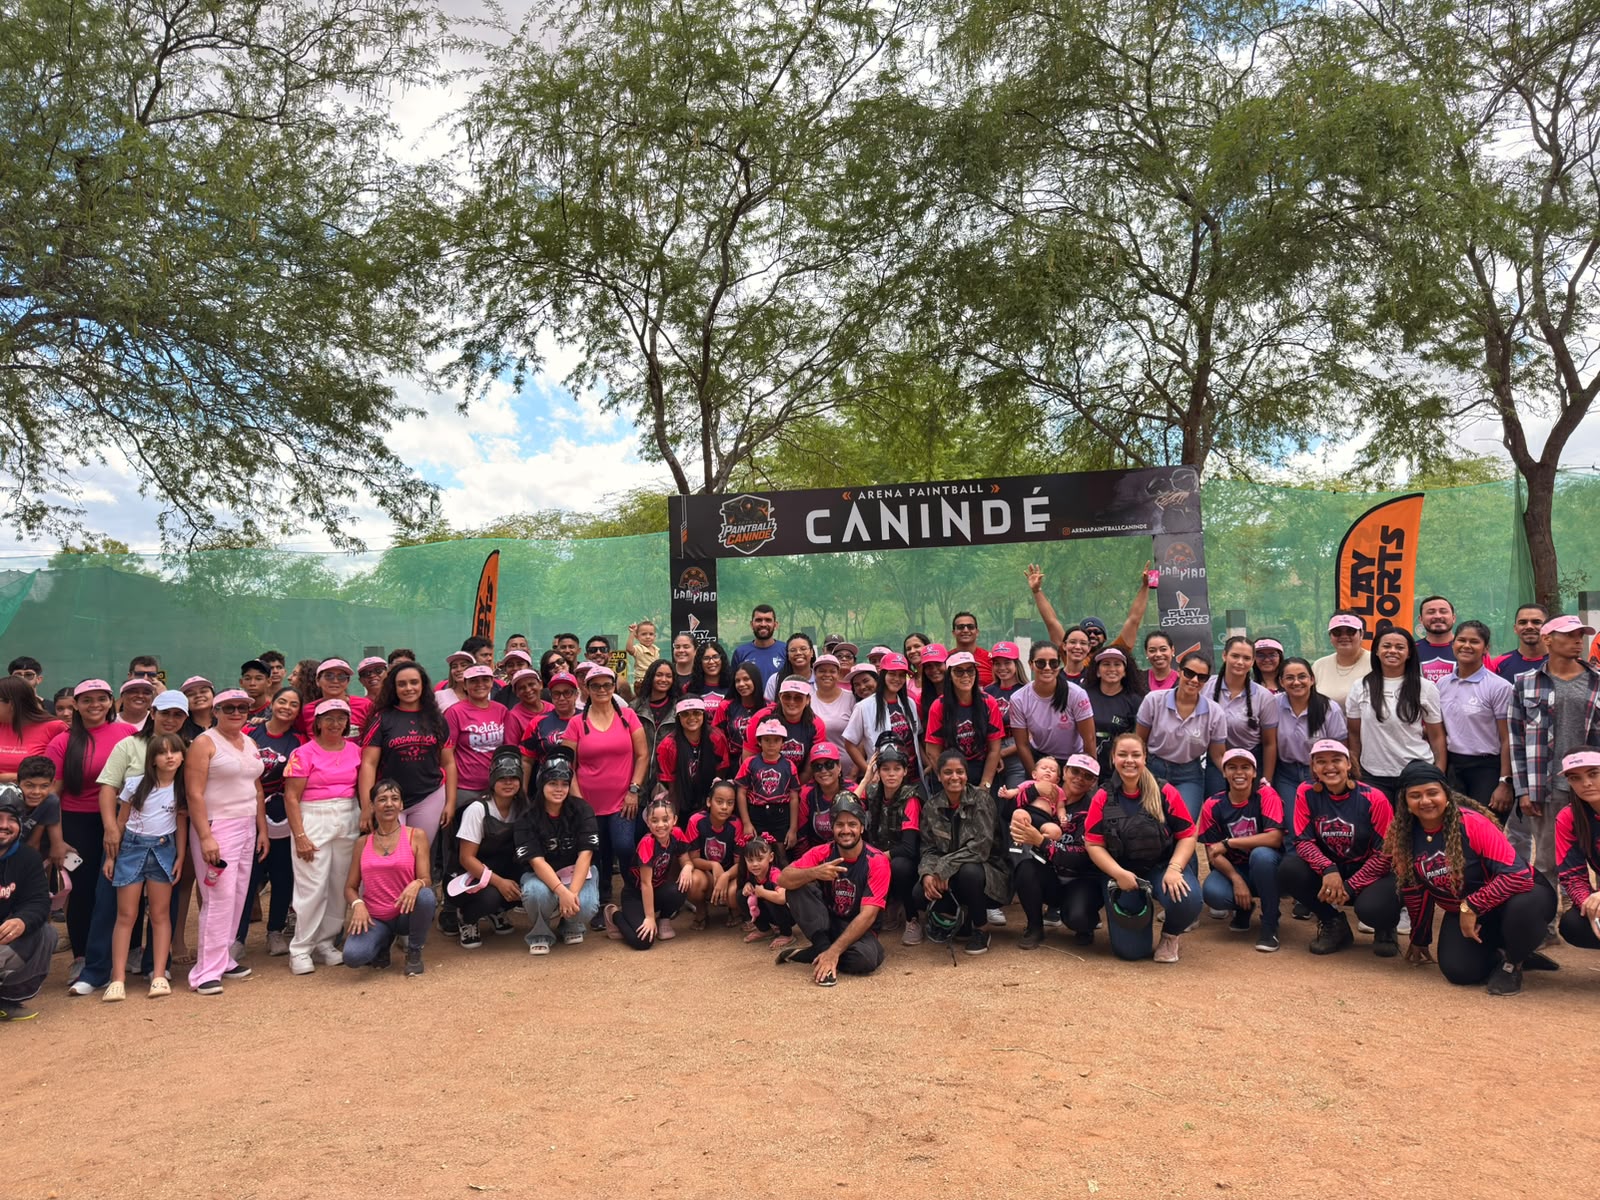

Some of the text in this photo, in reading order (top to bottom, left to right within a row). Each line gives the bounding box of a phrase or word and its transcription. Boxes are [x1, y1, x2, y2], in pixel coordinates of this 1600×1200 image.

[858, 484, 984, 500] ARENA PAINTBALL
[805, 486, 1050, 546] CANINDÉ
[723, 522, 772, 538] PAINTBALL
[1375, 525, 1405, 633] PORTS
[1161, 615, 1209, 626] SPORTS
[1168, 608, 1200, 617] PLAY
[1433, 874, 1452, 887] ROS
